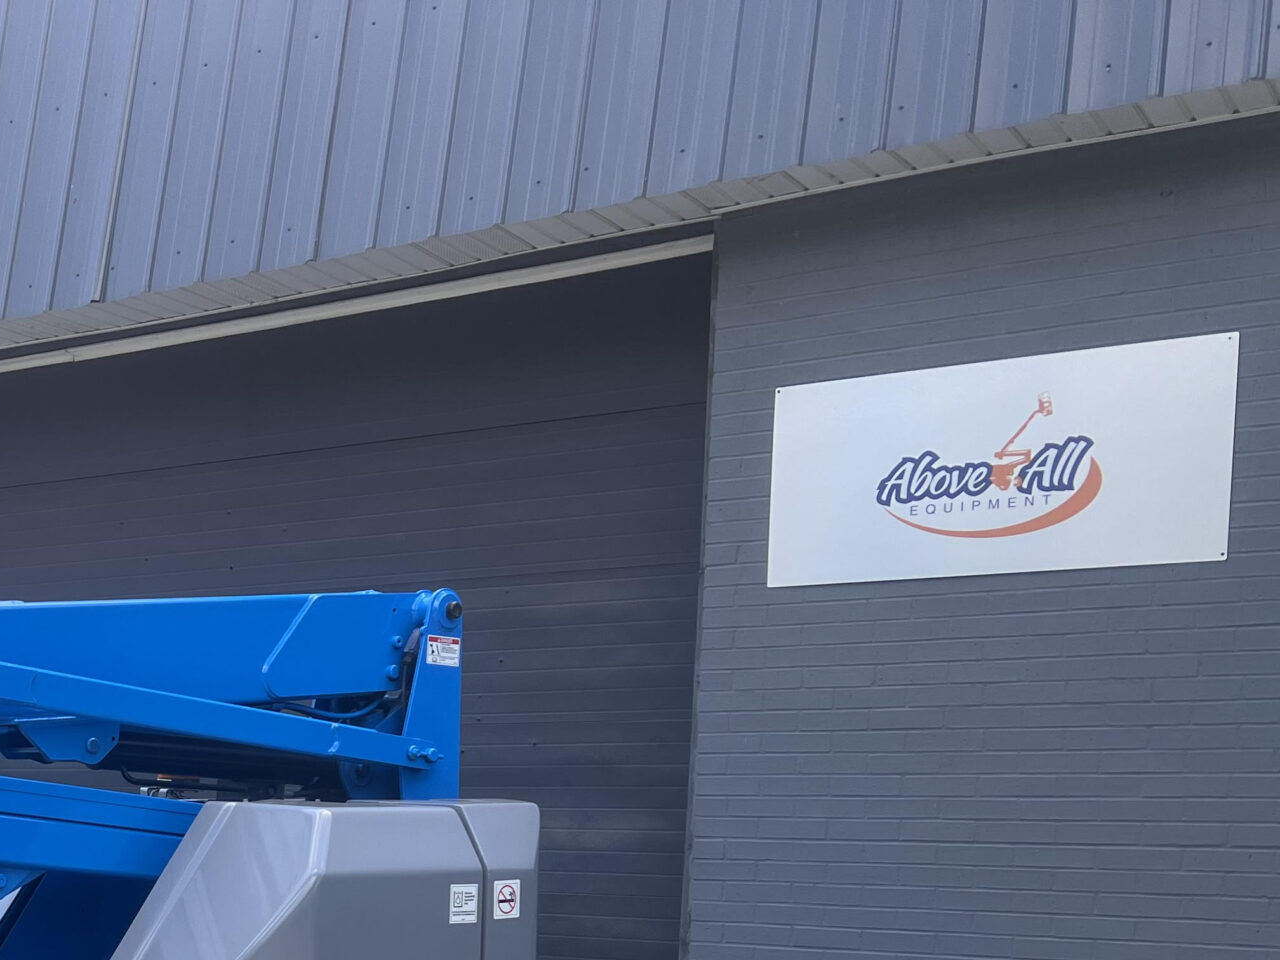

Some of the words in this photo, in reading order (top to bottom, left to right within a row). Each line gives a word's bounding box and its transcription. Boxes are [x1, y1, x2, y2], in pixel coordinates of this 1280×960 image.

[877, 451, 994, 507] Above
[1017, 436, 1094, 492] All
[909, 494, 1053, 517] EQUIPMENT
